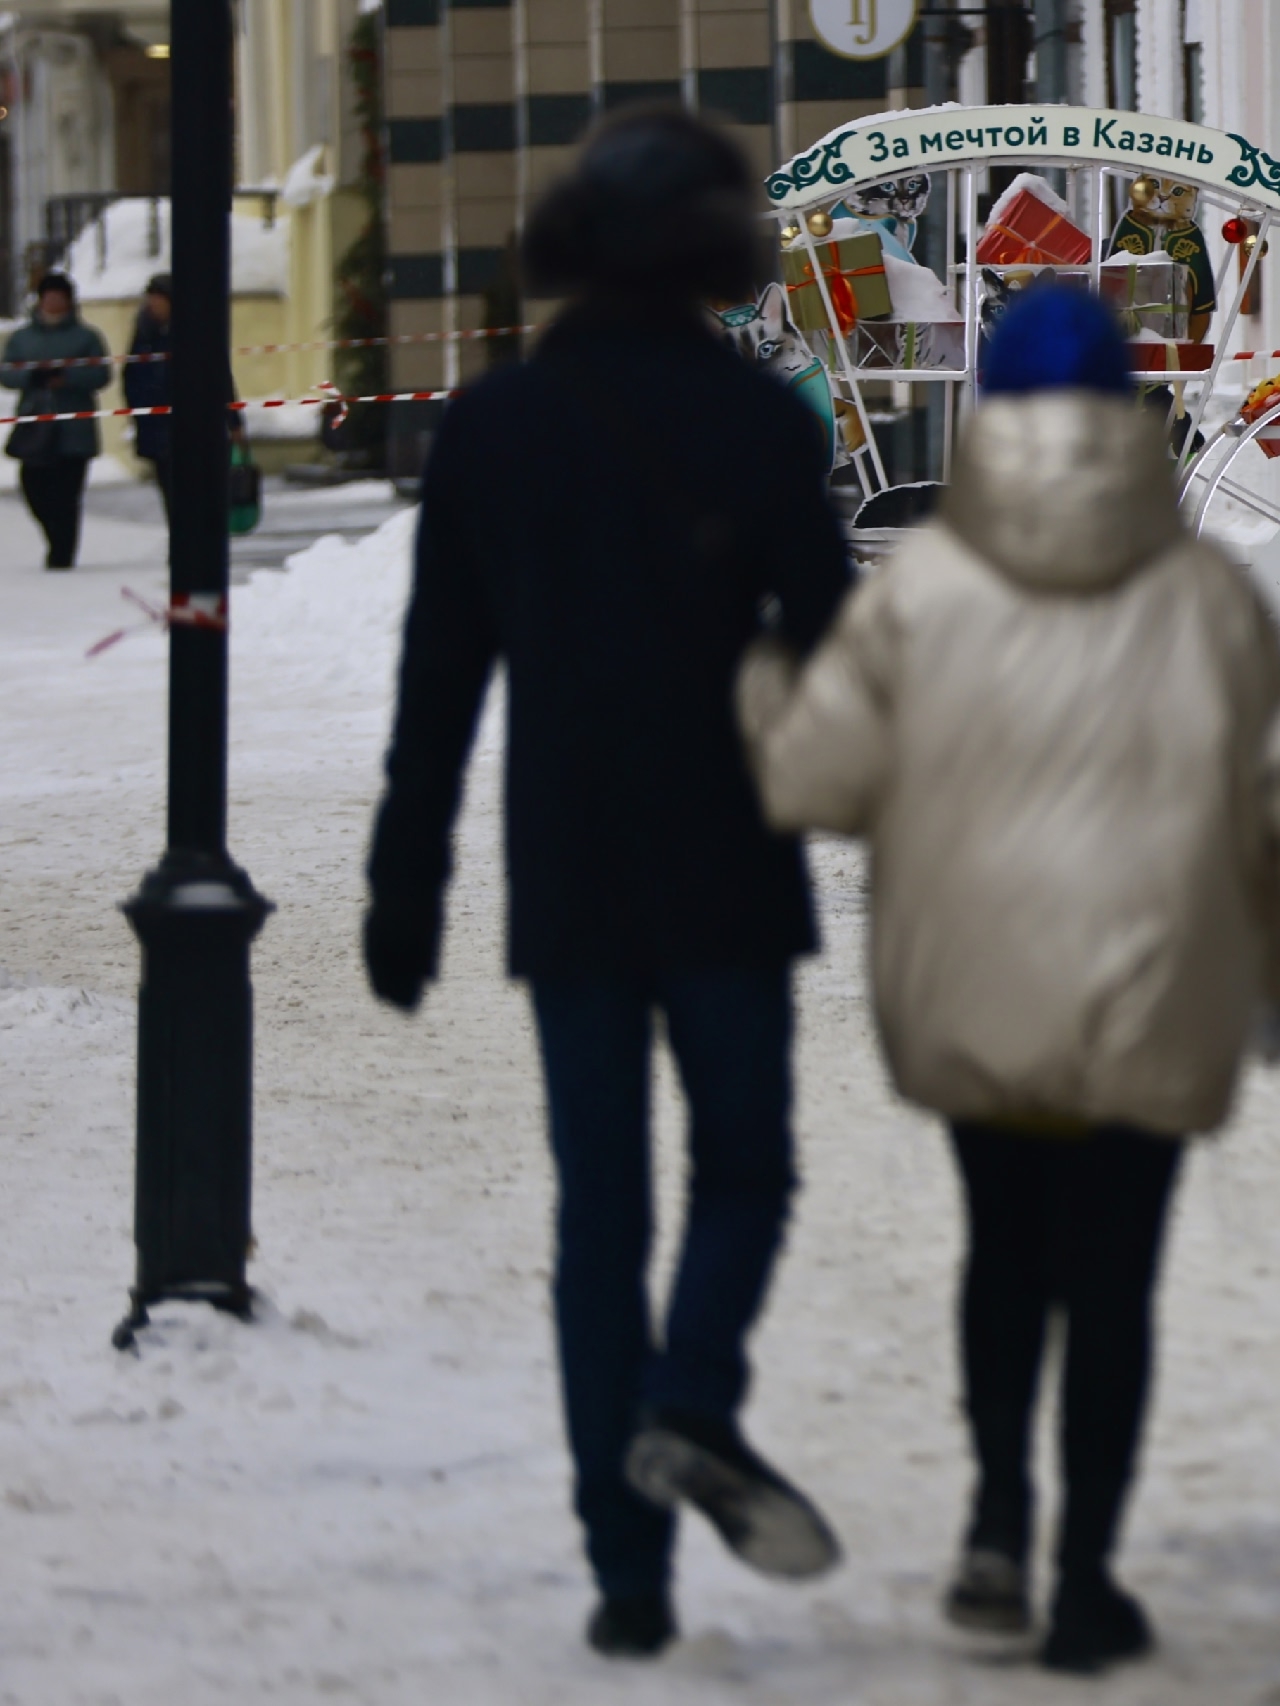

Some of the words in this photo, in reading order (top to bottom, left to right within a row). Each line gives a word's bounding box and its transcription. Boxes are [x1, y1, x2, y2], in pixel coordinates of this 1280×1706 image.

[866, 131, 911, 163] За
[919, 116, 1048, 153] мечтой
[1063, 126, 1081, 147] в
[1093, 117, 1214, 164] Казань
